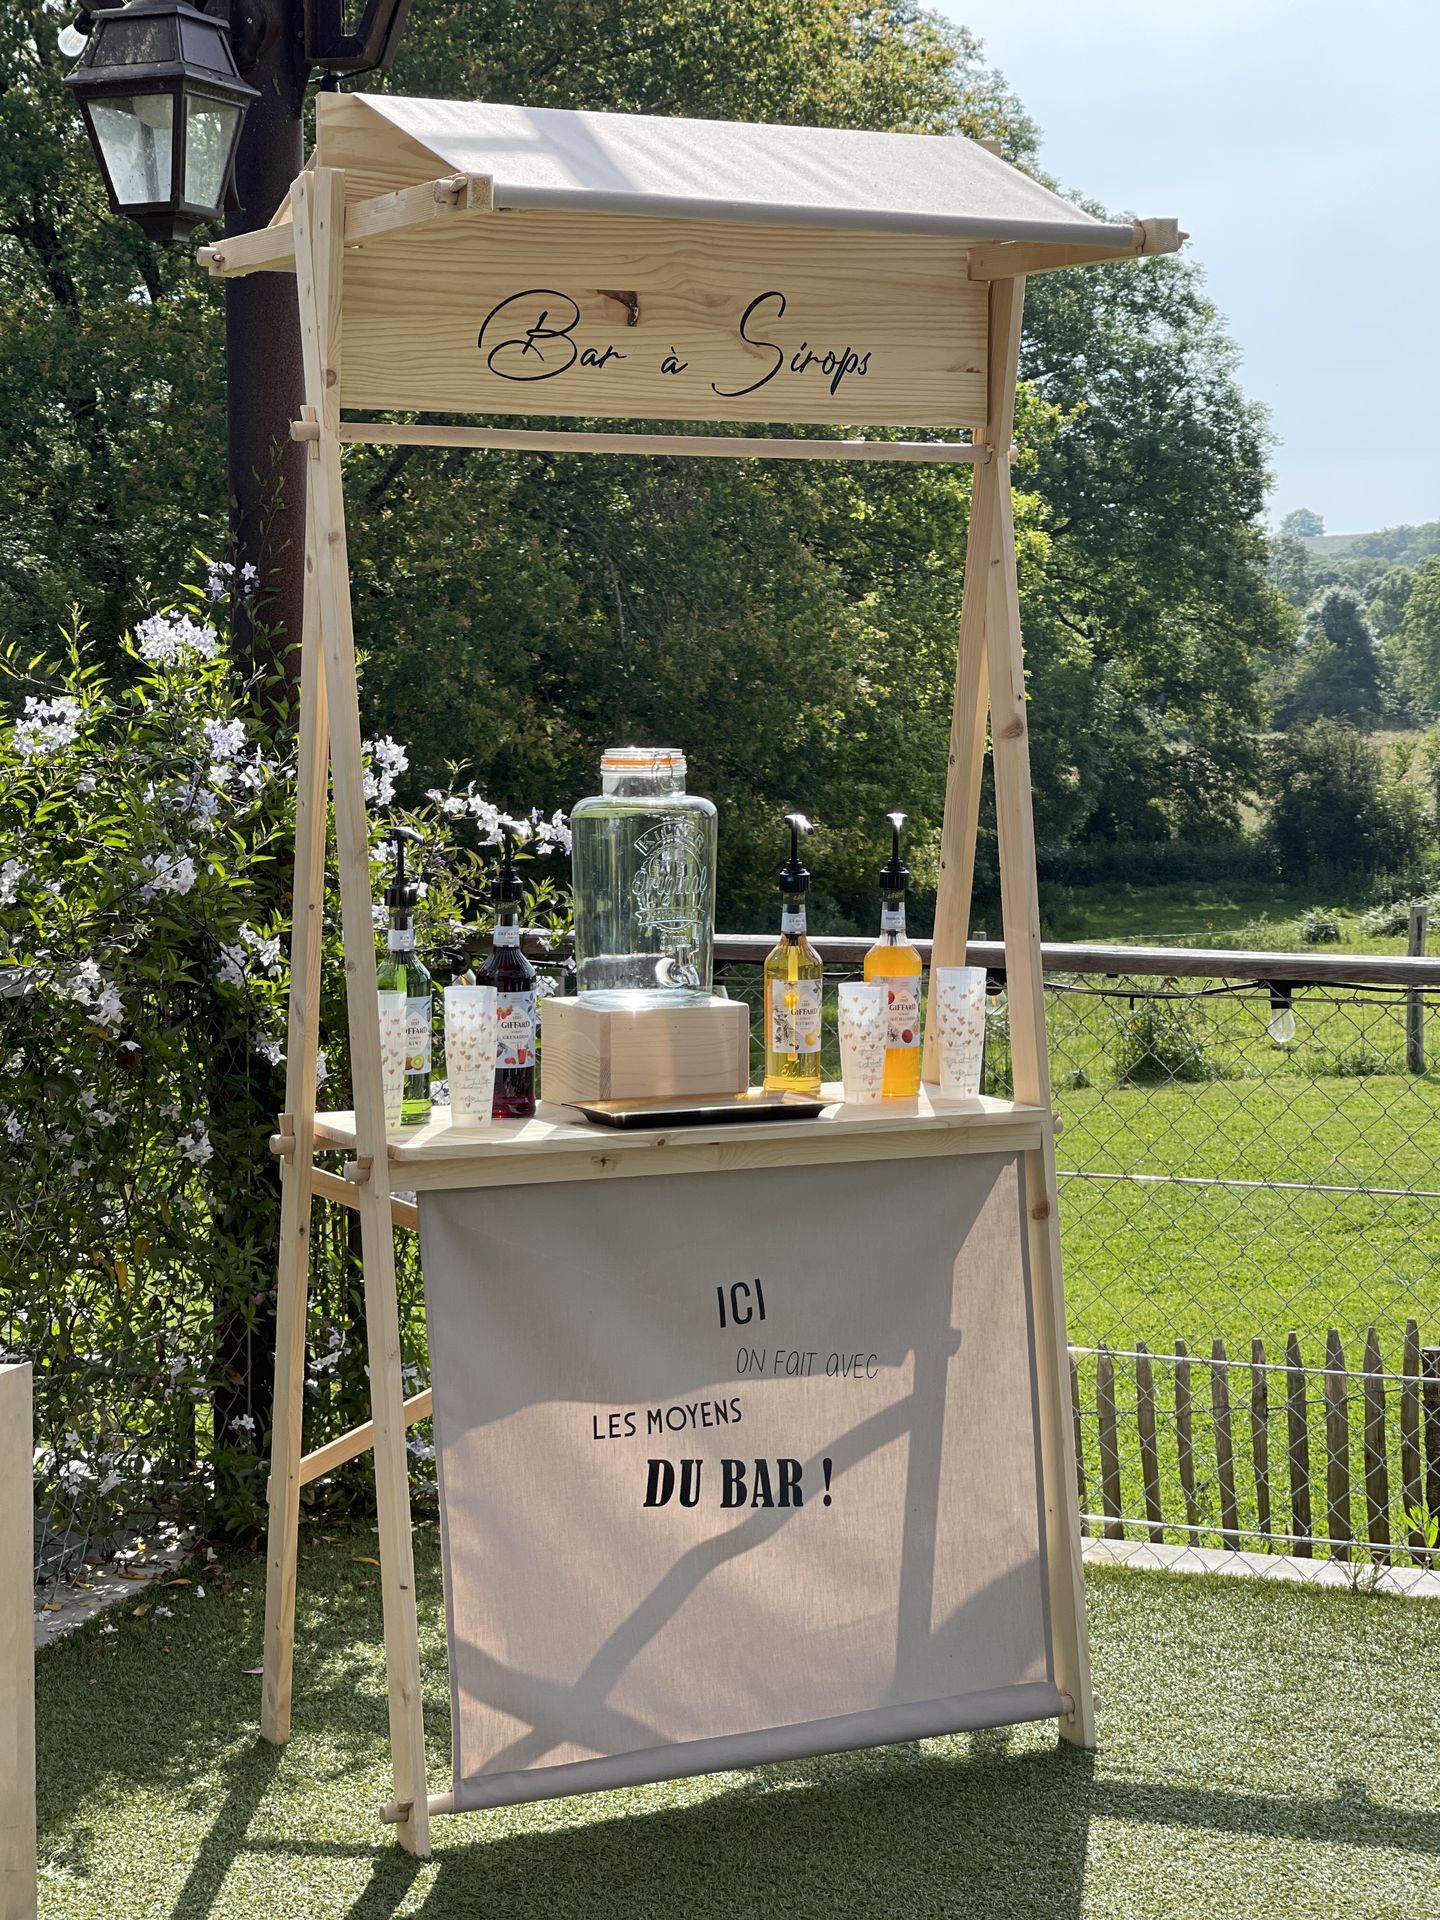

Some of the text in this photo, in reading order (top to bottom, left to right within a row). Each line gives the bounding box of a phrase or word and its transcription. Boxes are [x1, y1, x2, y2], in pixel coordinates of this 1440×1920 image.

[478, 289, 871, 397] Bar à Sirops
[790, 1007, 818, 1016] GIFFARD
[889, 1003, 916, 1011] GIFFARD
[501, 1020, 531, 1029] GIFFARD
[716, 1278, 766, 1328] ICI
[736, 1347, 765, 1374] ON
[593, 1398, 742, 1440] LES MOYENS
[642, 1459, 703, 1508] DU
[720, 1459, 804, 1508] BAR
